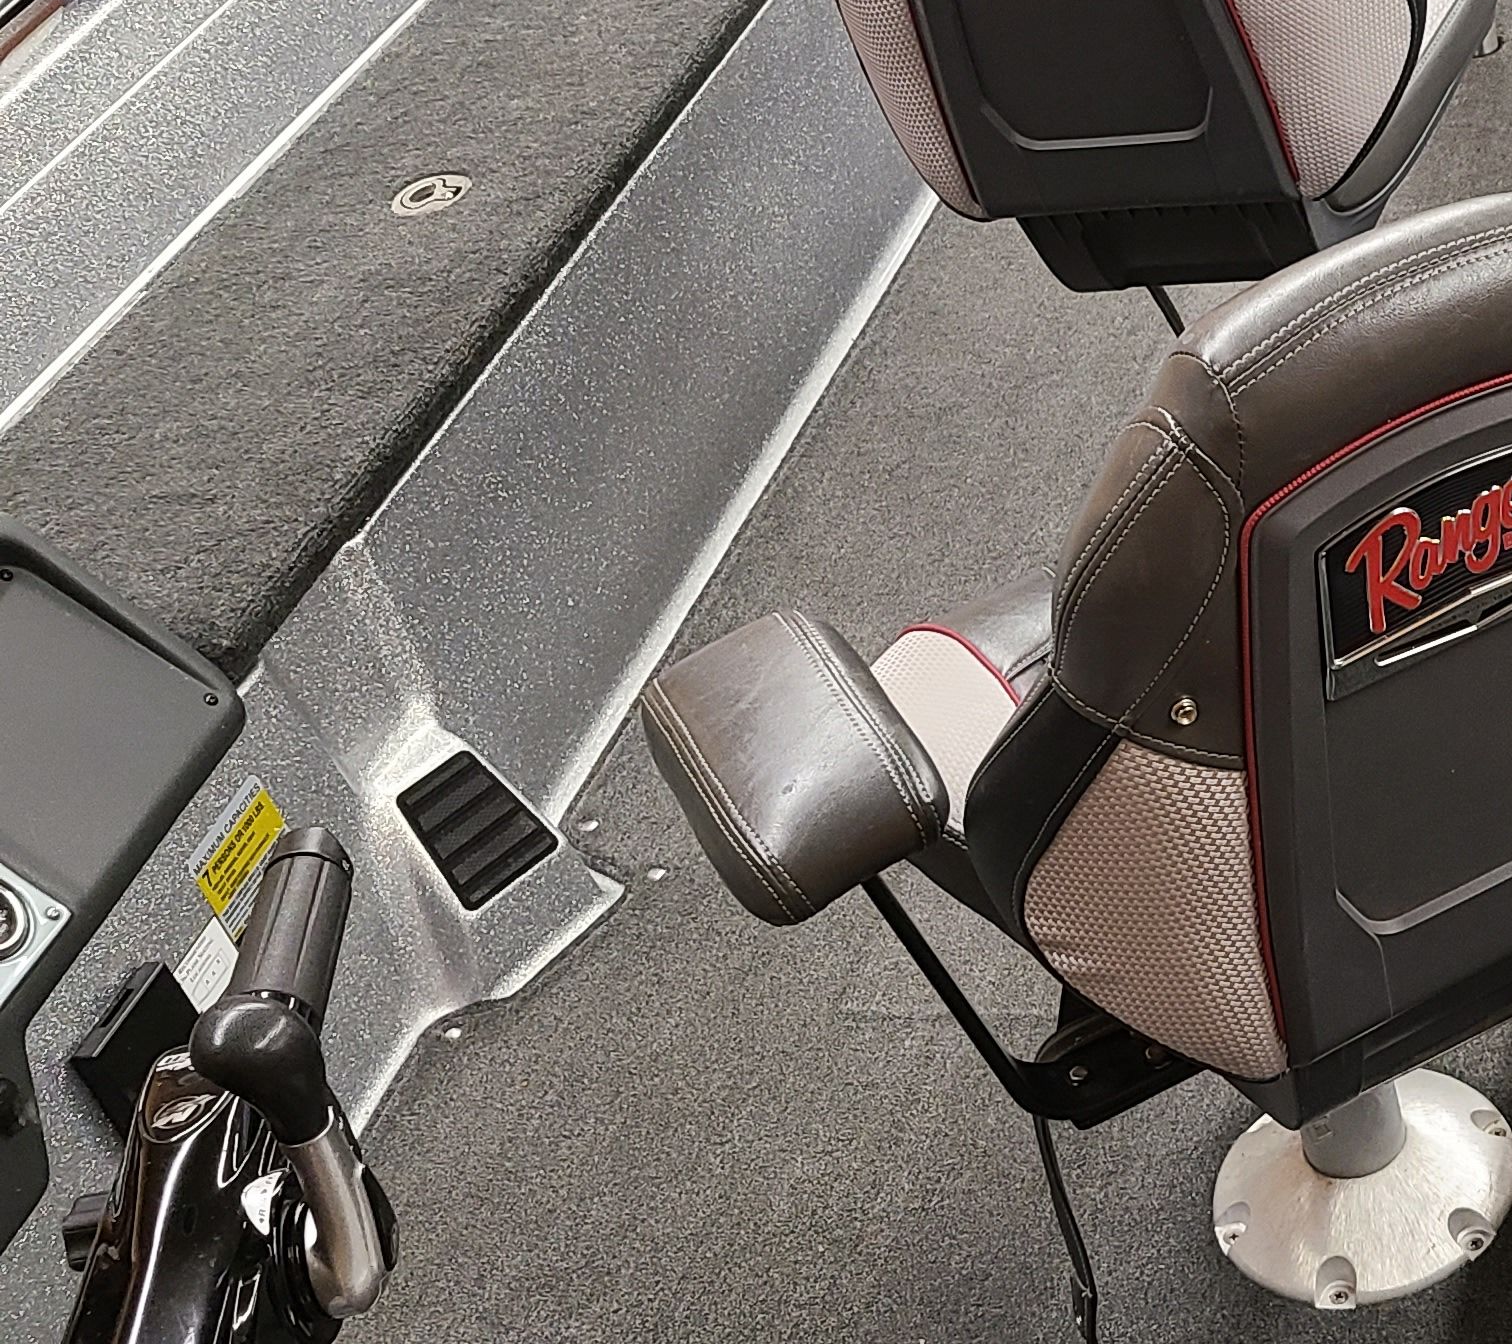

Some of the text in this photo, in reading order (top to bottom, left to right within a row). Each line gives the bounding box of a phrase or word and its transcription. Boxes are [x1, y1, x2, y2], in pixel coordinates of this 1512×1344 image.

[192, 831, 226, 876] MAXIMUM
[223, 782, 262, 835] CAPACITIES
[201, 868, 213, 887] 7
[211, 839, 236, 875] PERSONS
[234, 828, 245, 843] OR
